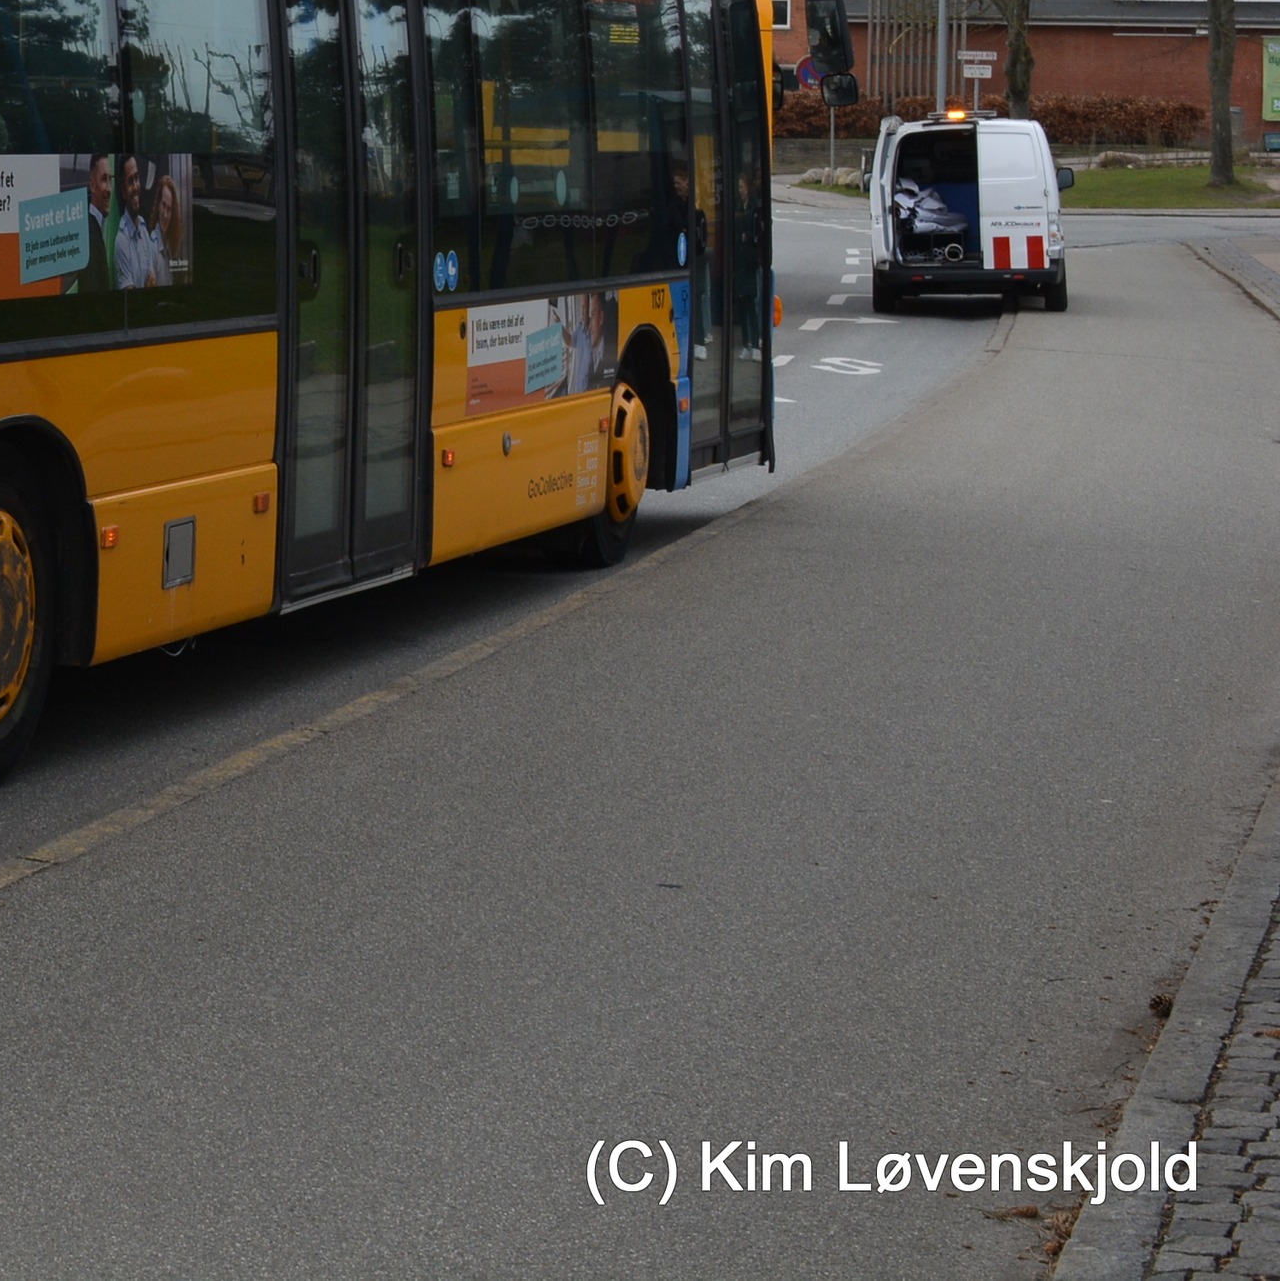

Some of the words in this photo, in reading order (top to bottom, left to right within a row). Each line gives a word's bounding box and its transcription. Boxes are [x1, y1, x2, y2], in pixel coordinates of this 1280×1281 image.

[5, 172, 14, 188] et
[24, 208, 54, 232] Svaret
[55, 209, 65, 224] er
[66, 201, 84, 221] Let!
[652, 288, 665, 309] 1137
[528, 470, 573, 499] GoCollective
